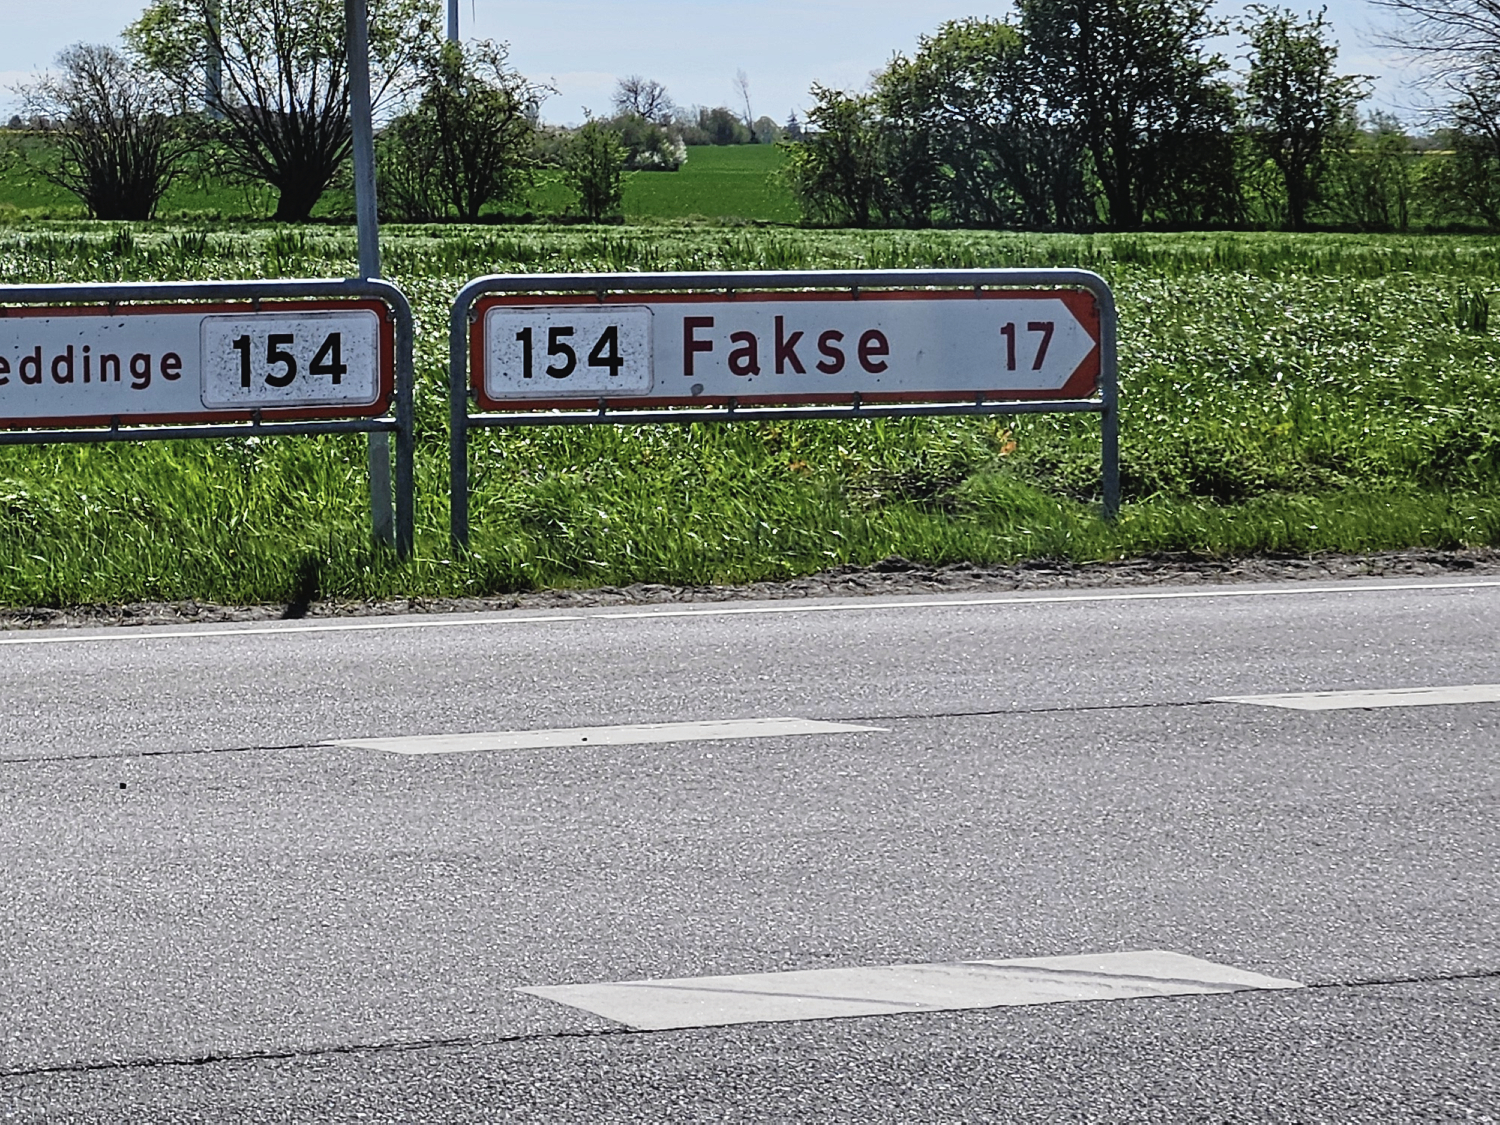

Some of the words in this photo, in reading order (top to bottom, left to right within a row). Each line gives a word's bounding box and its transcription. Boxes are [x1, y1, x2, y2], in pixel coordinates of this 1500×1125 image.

[232, 332, 348, 389] 154
[515, 325, 625, 379] 154
[683, 315, 890, 377] Fakse
[1000, 321, 1055, 372] 17
